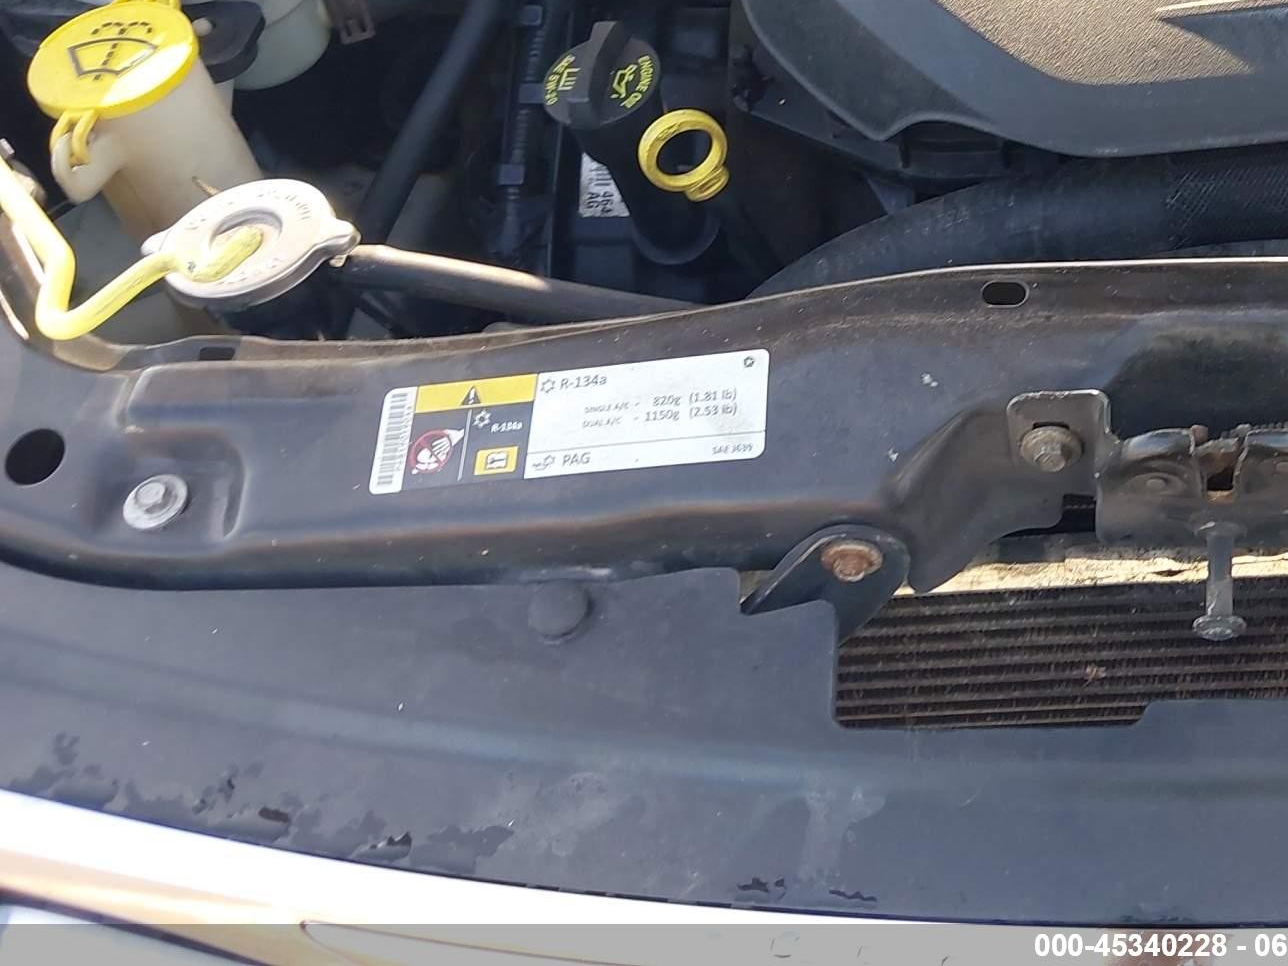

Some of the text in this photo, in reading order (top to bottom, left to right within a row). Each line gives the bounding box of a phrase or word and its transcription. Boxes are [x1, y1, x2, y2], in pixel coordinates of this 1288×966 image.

[635, 54, 654, 92] ENGINE
[560, 375, 607, 390] R-134a
[562, 452, 591, 466] PAG
